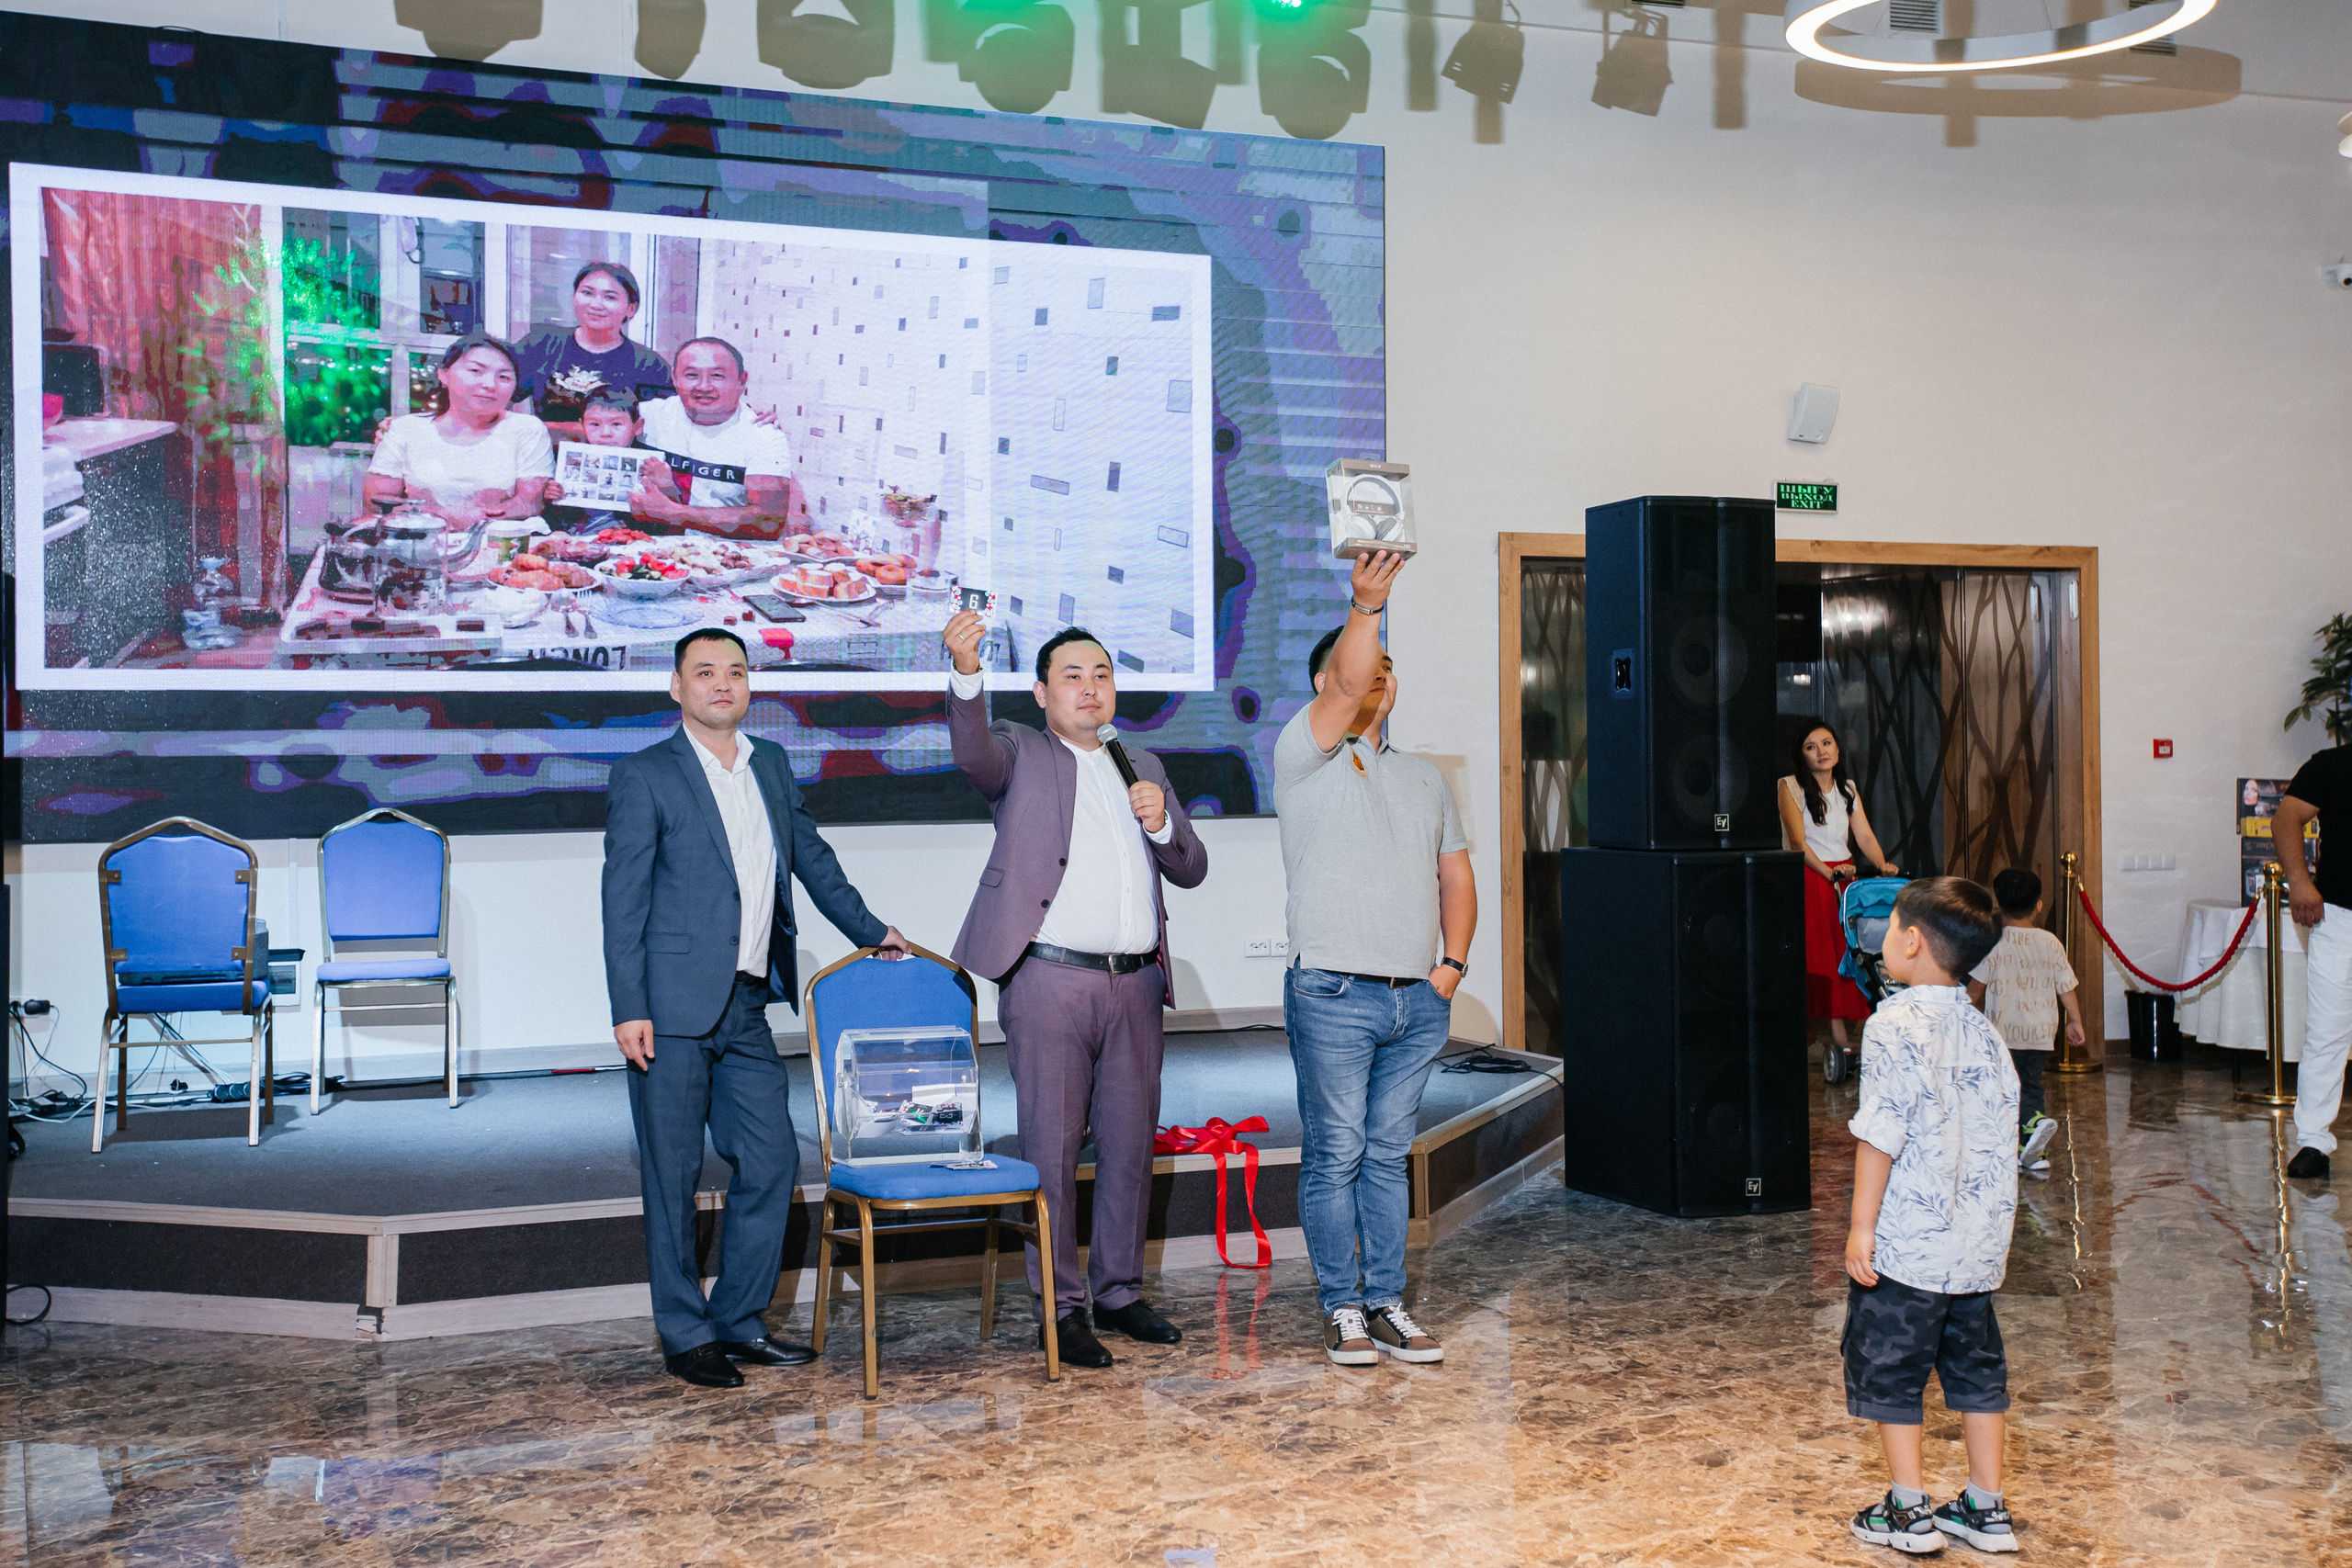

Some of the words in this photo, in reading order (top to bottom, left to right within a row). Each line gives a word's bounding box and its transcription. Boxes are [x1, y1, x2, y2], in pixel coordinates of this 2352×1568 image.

[671, 457, 735, 479] LFIGER
[1781, 492, 1833, 502] ВЫХОД
[1791, 500, 1823, 509] EXIT
[968, 593, 978, 609] 6
